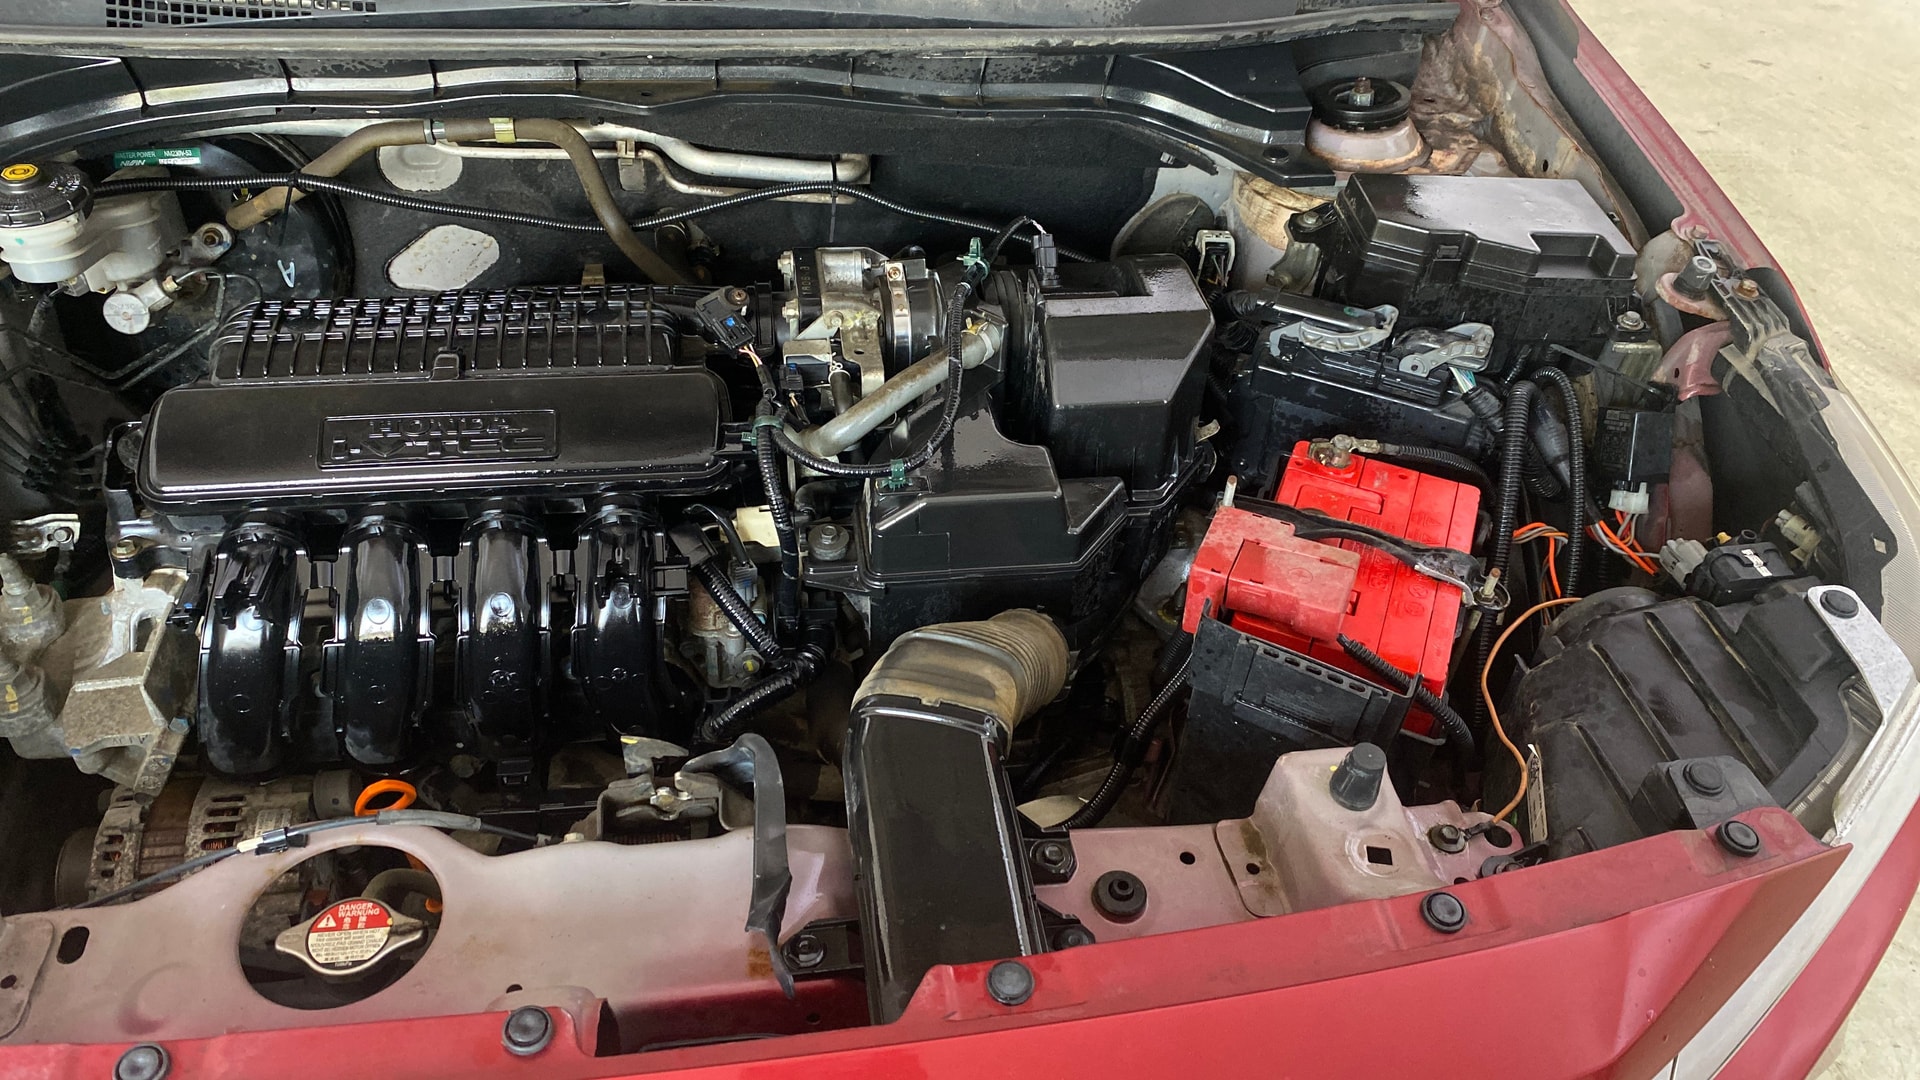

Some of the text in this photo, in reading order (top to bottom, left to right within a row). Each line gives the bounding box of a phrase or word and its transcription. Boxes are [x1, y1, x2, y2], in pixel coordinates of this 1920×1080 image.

[368, 417, 528, 439] HONDA
[338, 903, 373, 911] DANGER
[338, 908, 380, 918] WARNUNG
